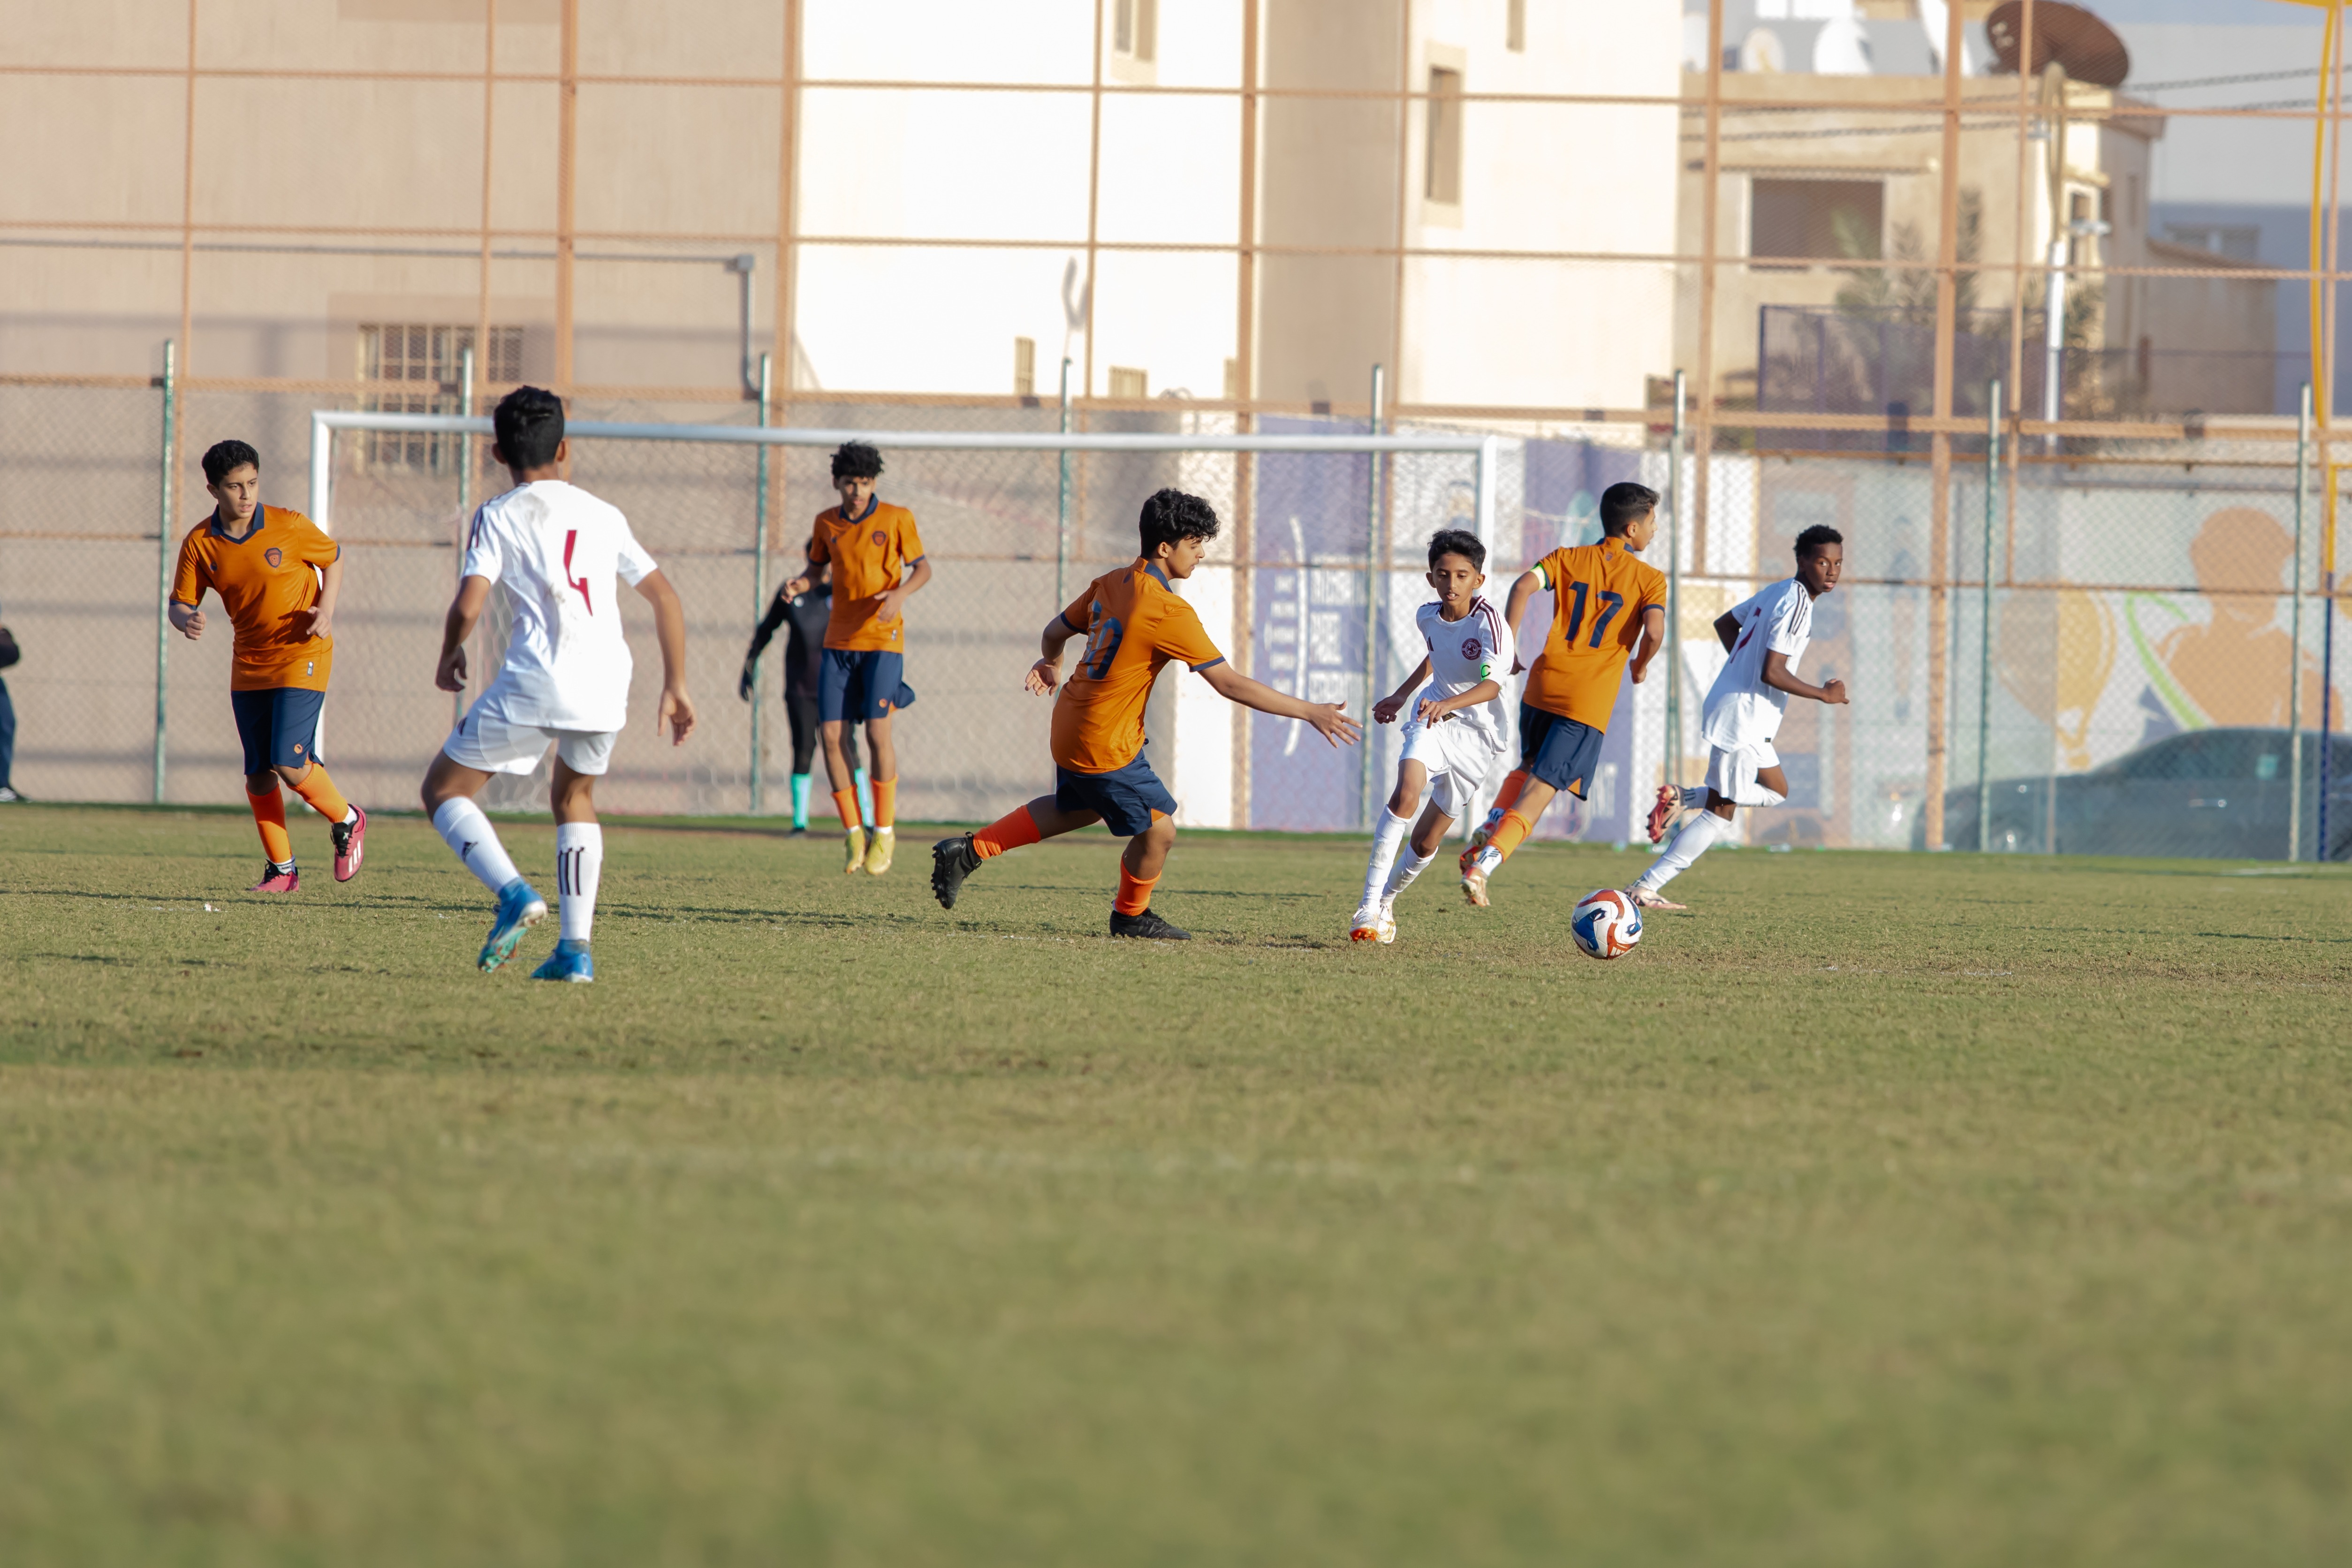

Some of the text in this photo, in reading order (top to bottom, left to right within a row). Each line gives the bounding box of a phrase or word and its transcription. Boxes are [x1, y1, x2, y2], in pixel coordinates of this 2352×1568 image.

[563, 530, 593, 616] 4
[1565, 581, 1624, 649] 17
[1481, 665, 1491, 678] C
